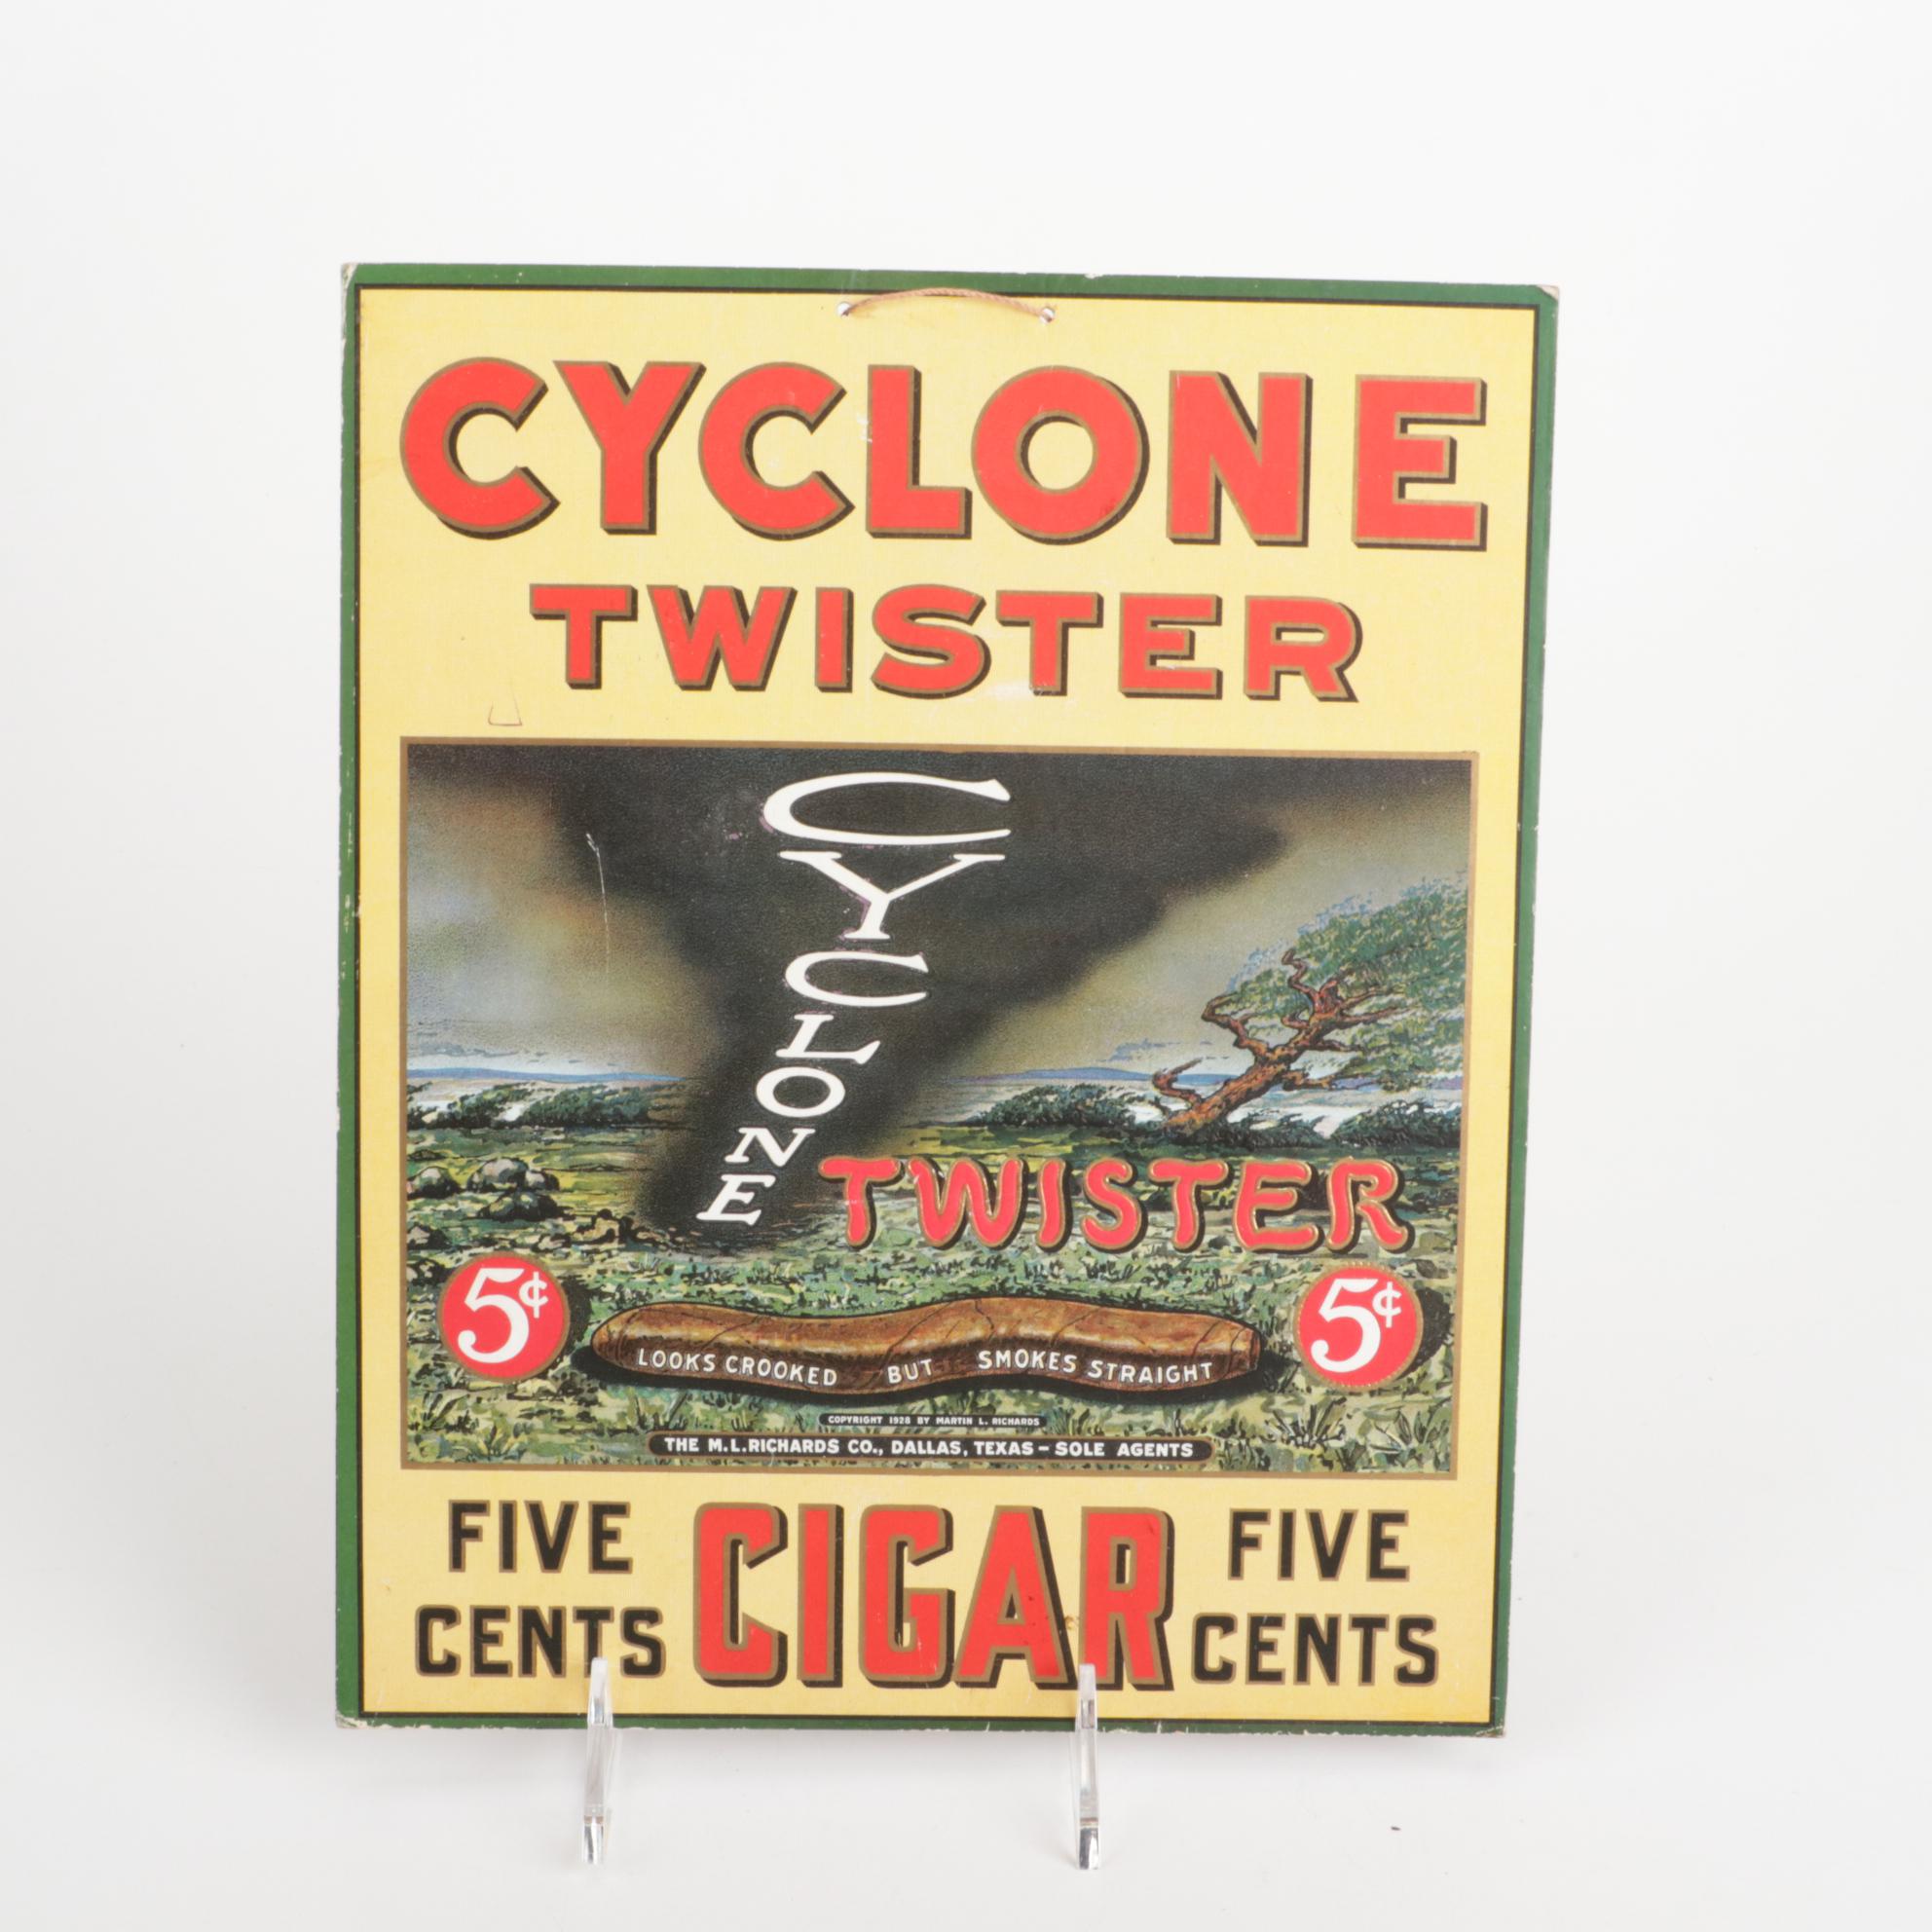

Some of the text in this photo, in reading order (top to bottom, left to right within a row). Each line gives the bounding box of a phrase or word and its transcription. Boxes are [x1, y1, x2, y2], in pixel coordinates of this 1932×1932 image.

[399, 356, 1487, 551] CYCLONE
[529, 583, 1363, 702] TWISTER
[695, 771, 1012, 1226] CYCLONE
[819, 1155, 1415, 1253] TWISTER
[637, 1348, 1213, 1387] LOOKS CROOKED BUT SMOKES STRAIGHT
[664, 1436, 700, 1452] THE
[847, 1438, 884, 1456] CO.,
[891, 1439, 969, 1457] DALLAS,
[974, 1440, 1034, 1455] TEXAS
[1054, 1441, 1105, 1457] SOLE
[1117, 1442, 1194, 1458] AGENTS
[828, 1415, 1041, 1427] COPYRIGHT 1928 BY MARTIN L. RICHARDS
[448, 1500, 633, 1574] FIVE
[1228, 1508, 1410, 1581] FIVE
[692, 1502, 1174, 1691] CIGAR
[415, 1604, 666, 1678] CENTS
[1191, 1613, 1439, 1687] CENTS
